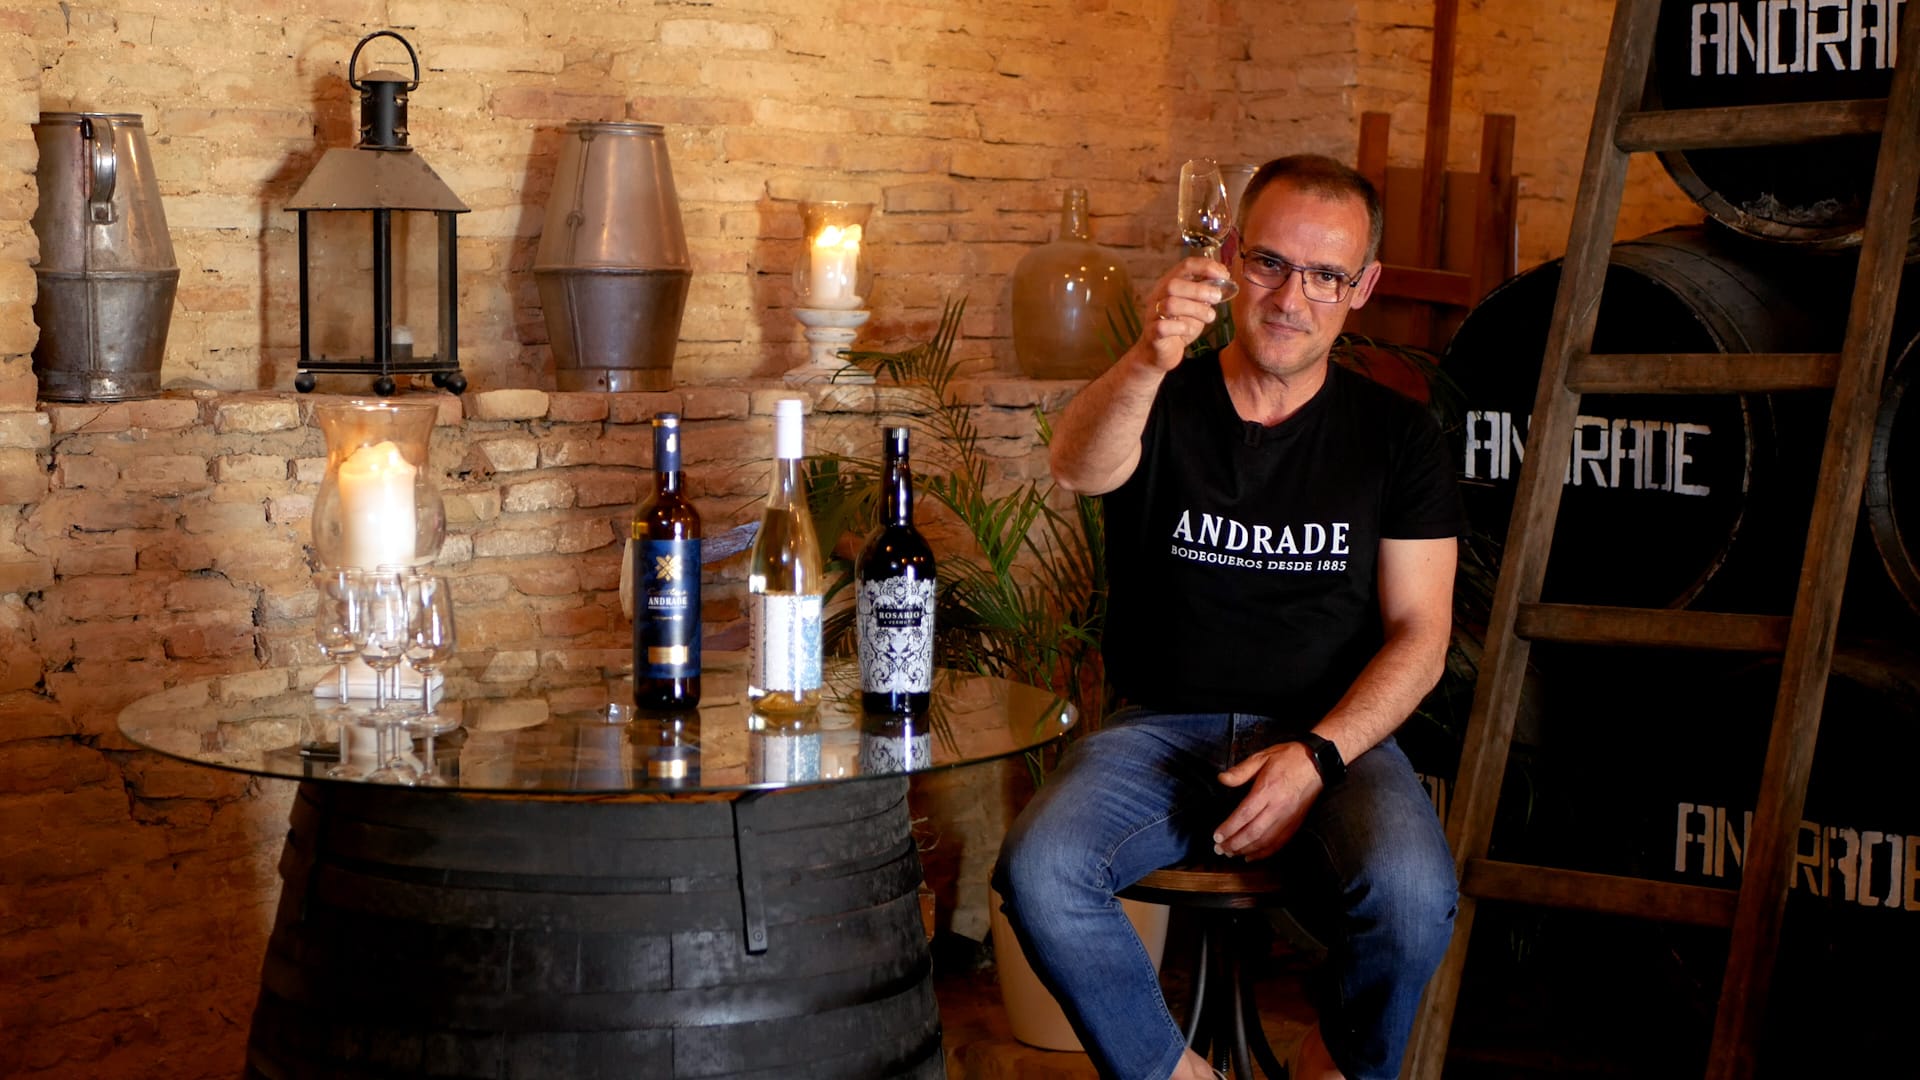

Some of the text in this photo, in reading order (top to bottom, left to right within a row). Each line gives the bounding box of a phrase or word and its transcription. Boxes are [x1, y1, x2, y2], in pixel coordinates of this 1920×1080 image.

[1465, 411, 1711, 496] ANRADE
[1172, 509, 1350, 555] ANDRADE
[1171, 544, 1347, 572] BODEGUEROS DESDE 1885
[648, 596, 688, 606] ANDRADE
[879, 611, 920, 620] ROSARIO
